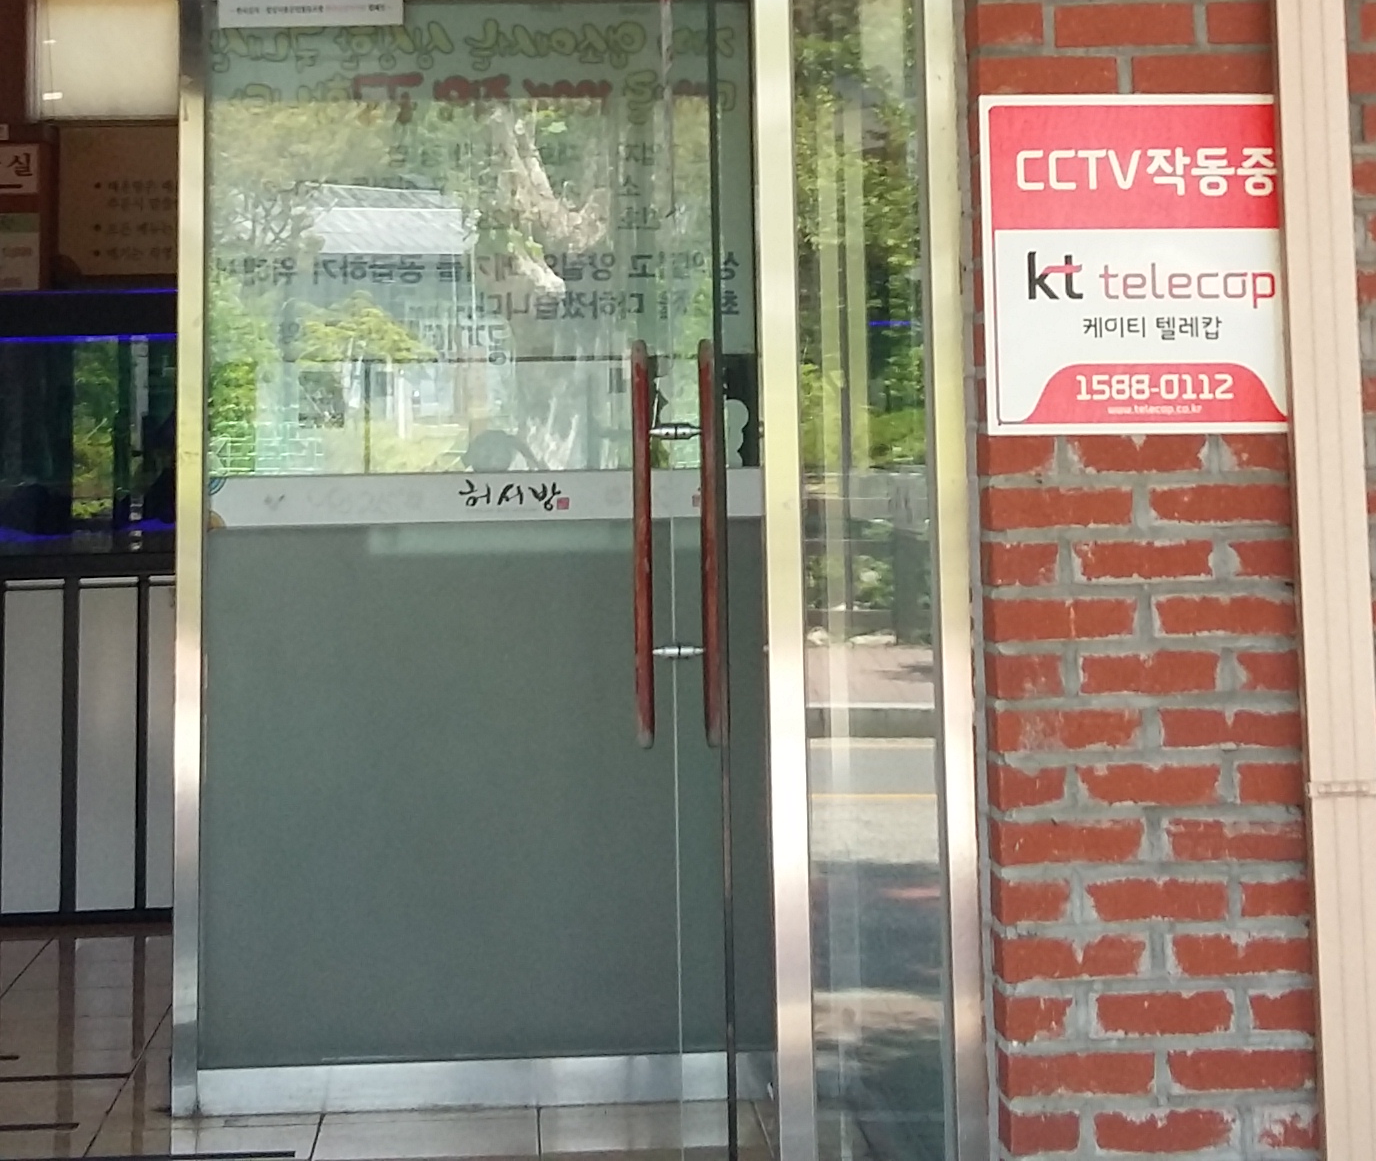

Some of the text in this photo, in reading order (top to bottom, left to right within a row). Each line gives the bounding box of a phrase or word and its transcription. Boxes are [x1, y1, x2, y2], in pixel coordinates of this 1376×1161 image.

[1026, 250, 1276, 310] kt telecop
[1082, 316, 1223, 341] 케이티 텔레캅
[1075, 373, 1235, 401] 1588-0112
[1107, 404, 1203, 416] www.telecop.co.kr
